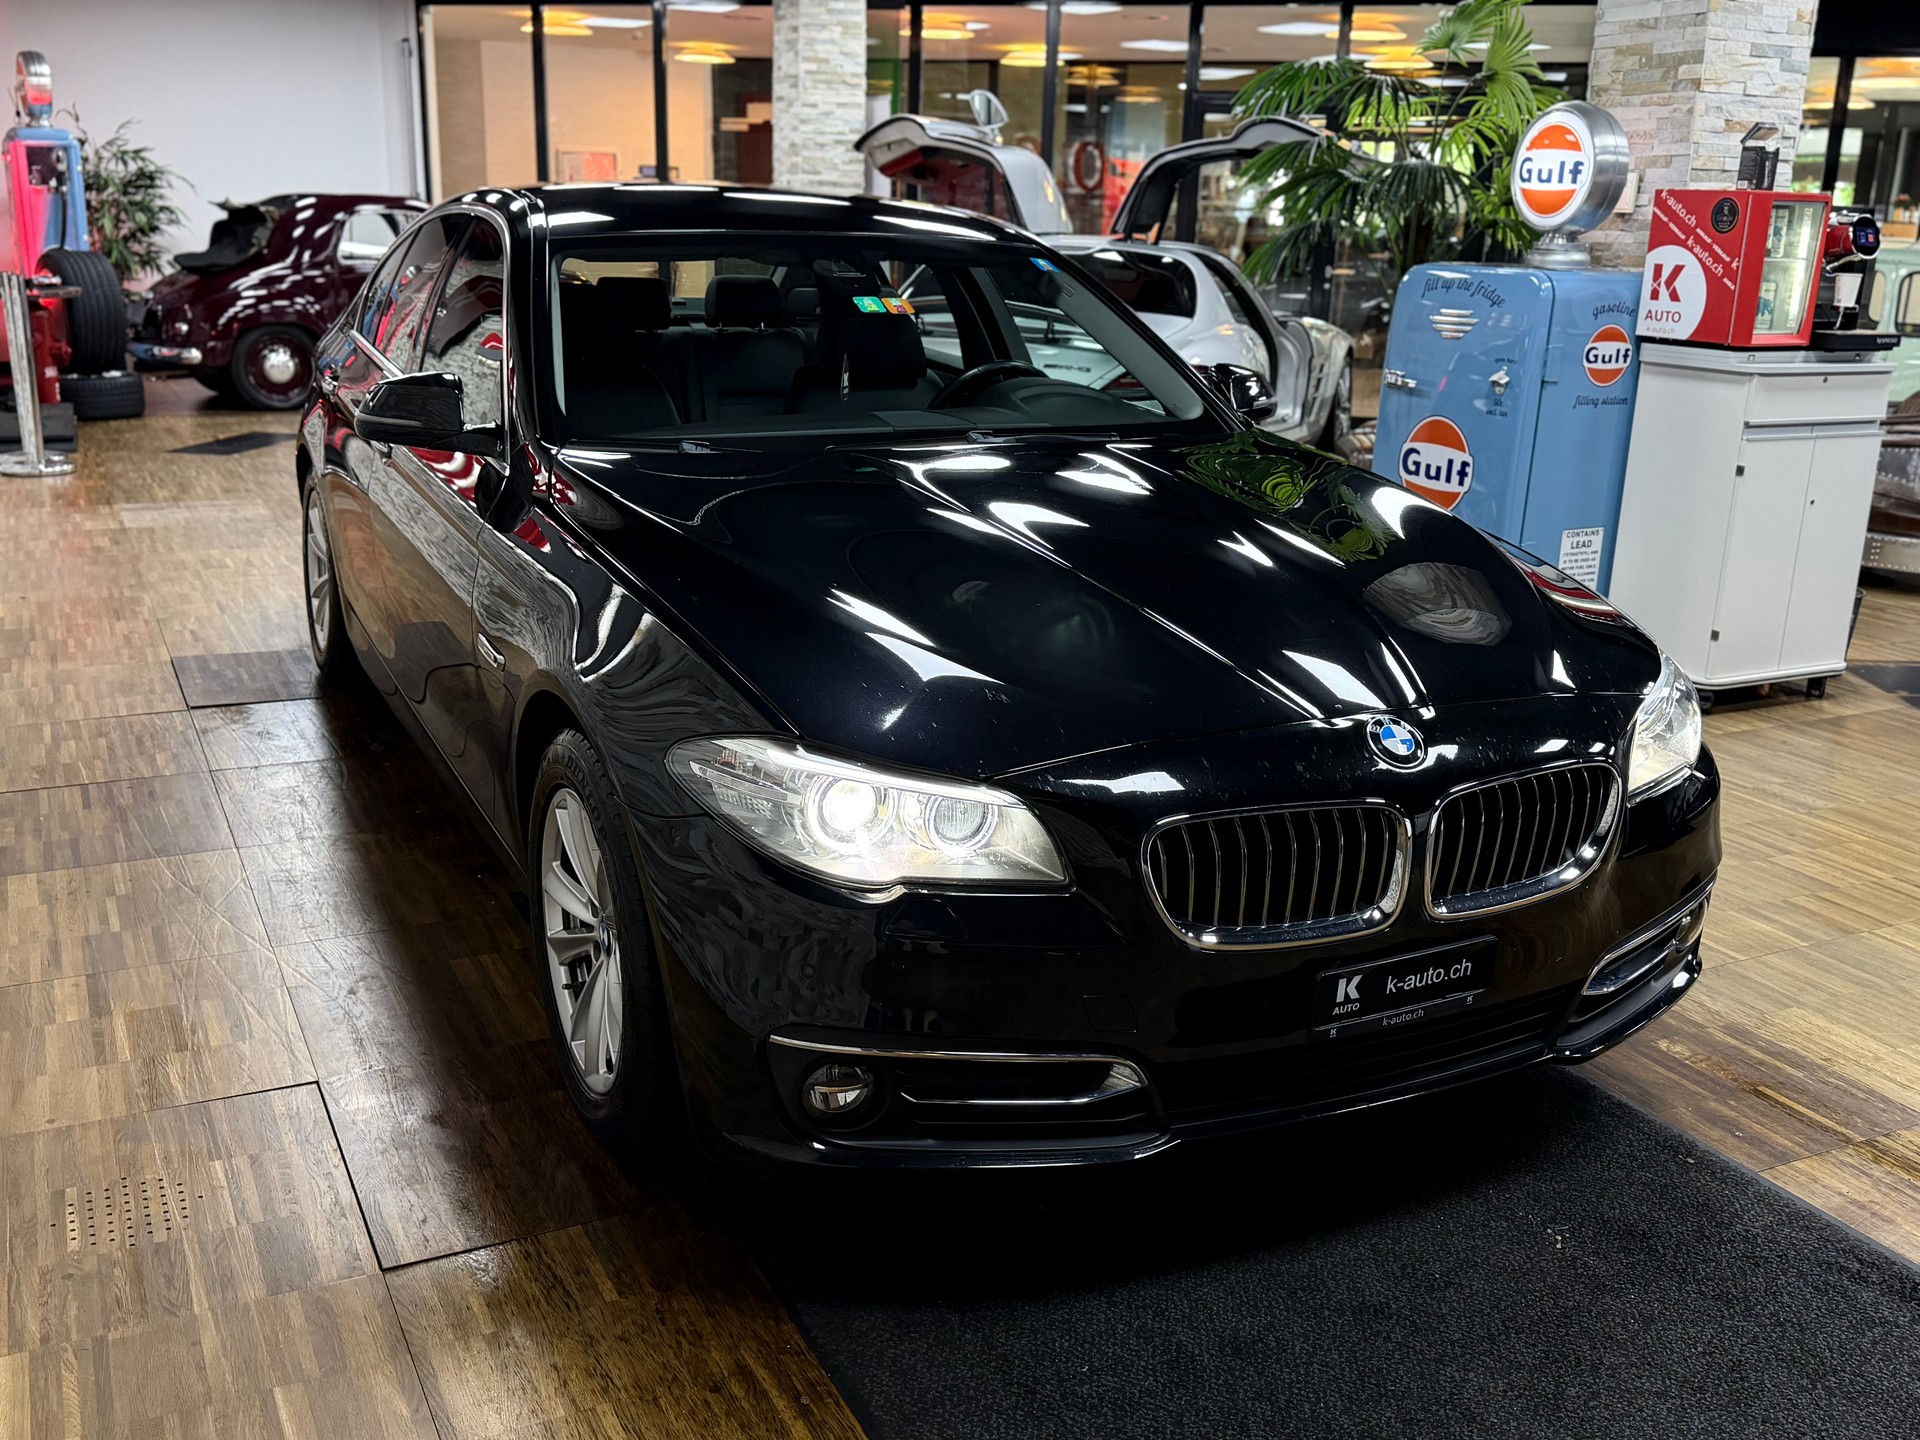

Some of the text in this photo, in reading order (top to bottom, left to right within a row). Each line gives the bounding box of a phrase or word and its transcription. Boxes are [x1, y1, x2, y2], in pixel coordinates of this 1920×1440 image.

[1519, 156, 1585, 185] Gulf
[1660, 189, 1697, 228] k-auto.ch
[1686, 235, 1724, 277] k-auto.ch
[1421, 277, 1506, 308] fill up the fridge
[1649, 263, 1686, 303] K
[1592, 300, 1636, 321] gasoline
[1644, 309, 1682, 323] AUTO
[1646, 325, 1675, 334] k-auto.ch
[1585, 346, 1631, 364] Gulf
[1572, 394, 1628, 409] filling station
[1401, 447, 1471, 487] Gulf
[1566, 529, 1600, 538] CONTAINS
[1570, 539, 1593, 550] LEAD
[1336, 959, 1472, 1003] K k-auto.ch
[1332, 1002, 1360, 1016] AUTO
[1382, 1009, 1424, 1026] k-auto.ch
